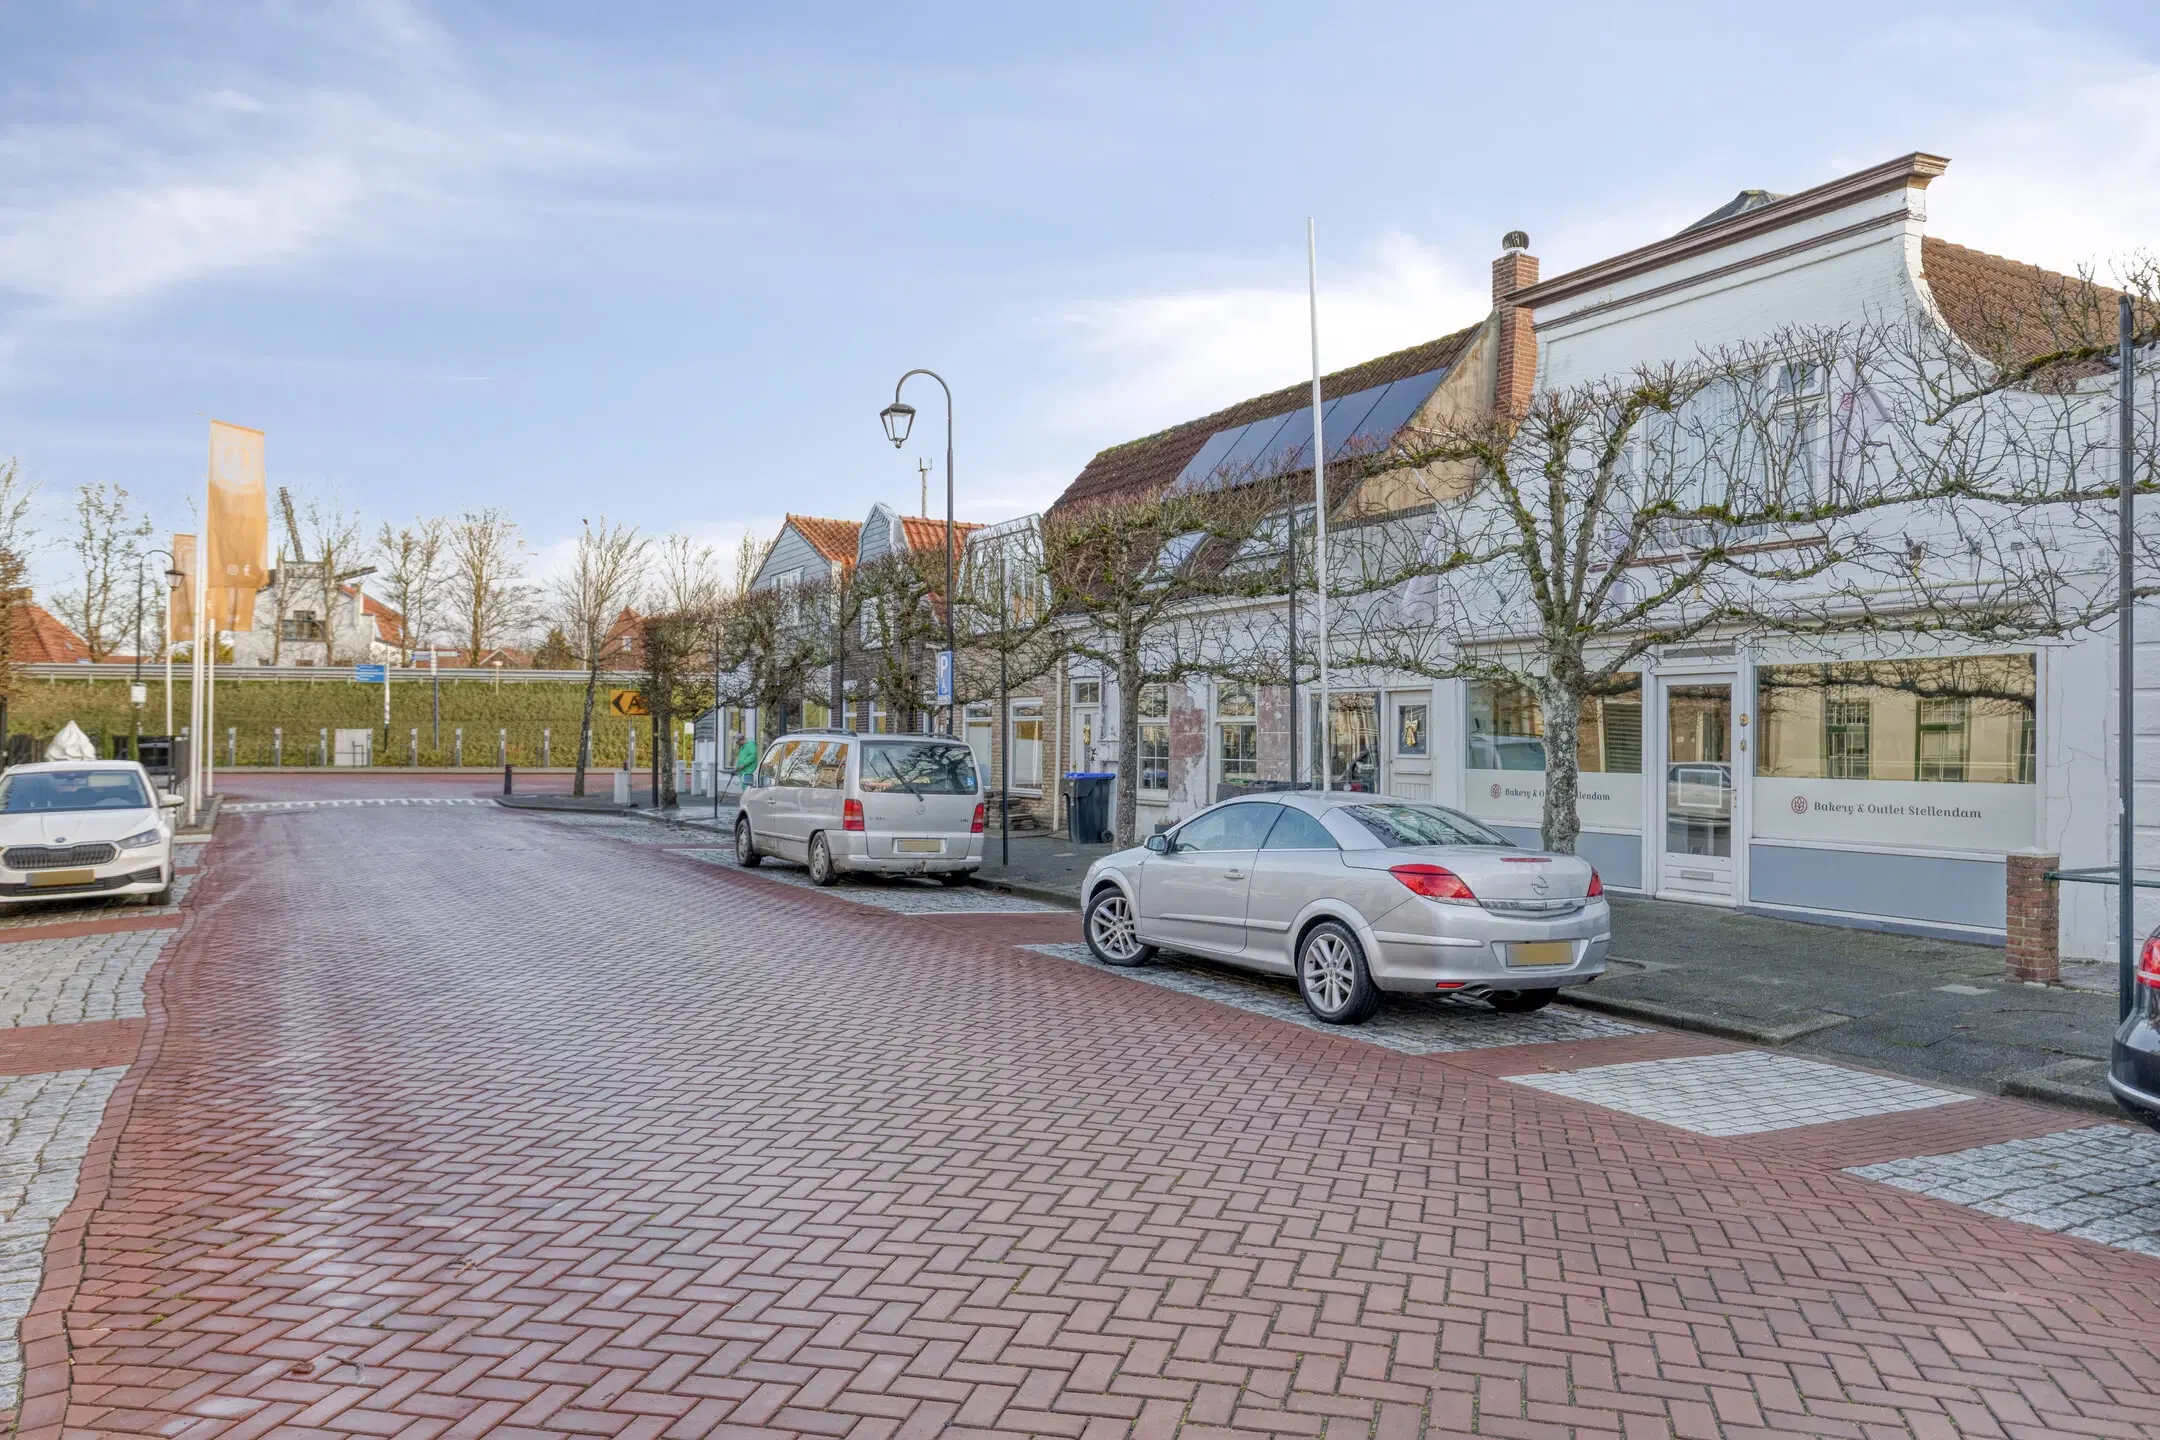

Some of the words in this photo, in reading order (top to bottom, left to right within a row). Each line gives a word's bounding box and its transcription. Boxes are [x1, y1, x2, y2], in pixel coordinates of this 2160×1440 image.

[940, 655, 948, 679] P
[1505, 788, 1531, 798] Bakery
[1814, 801, 1854, 815] Bakery
[1857, 804, 1864, 813] &
[1867, 803, 1905, 816] Outlet
[1908, 805, 1982, 819] Stellendam
